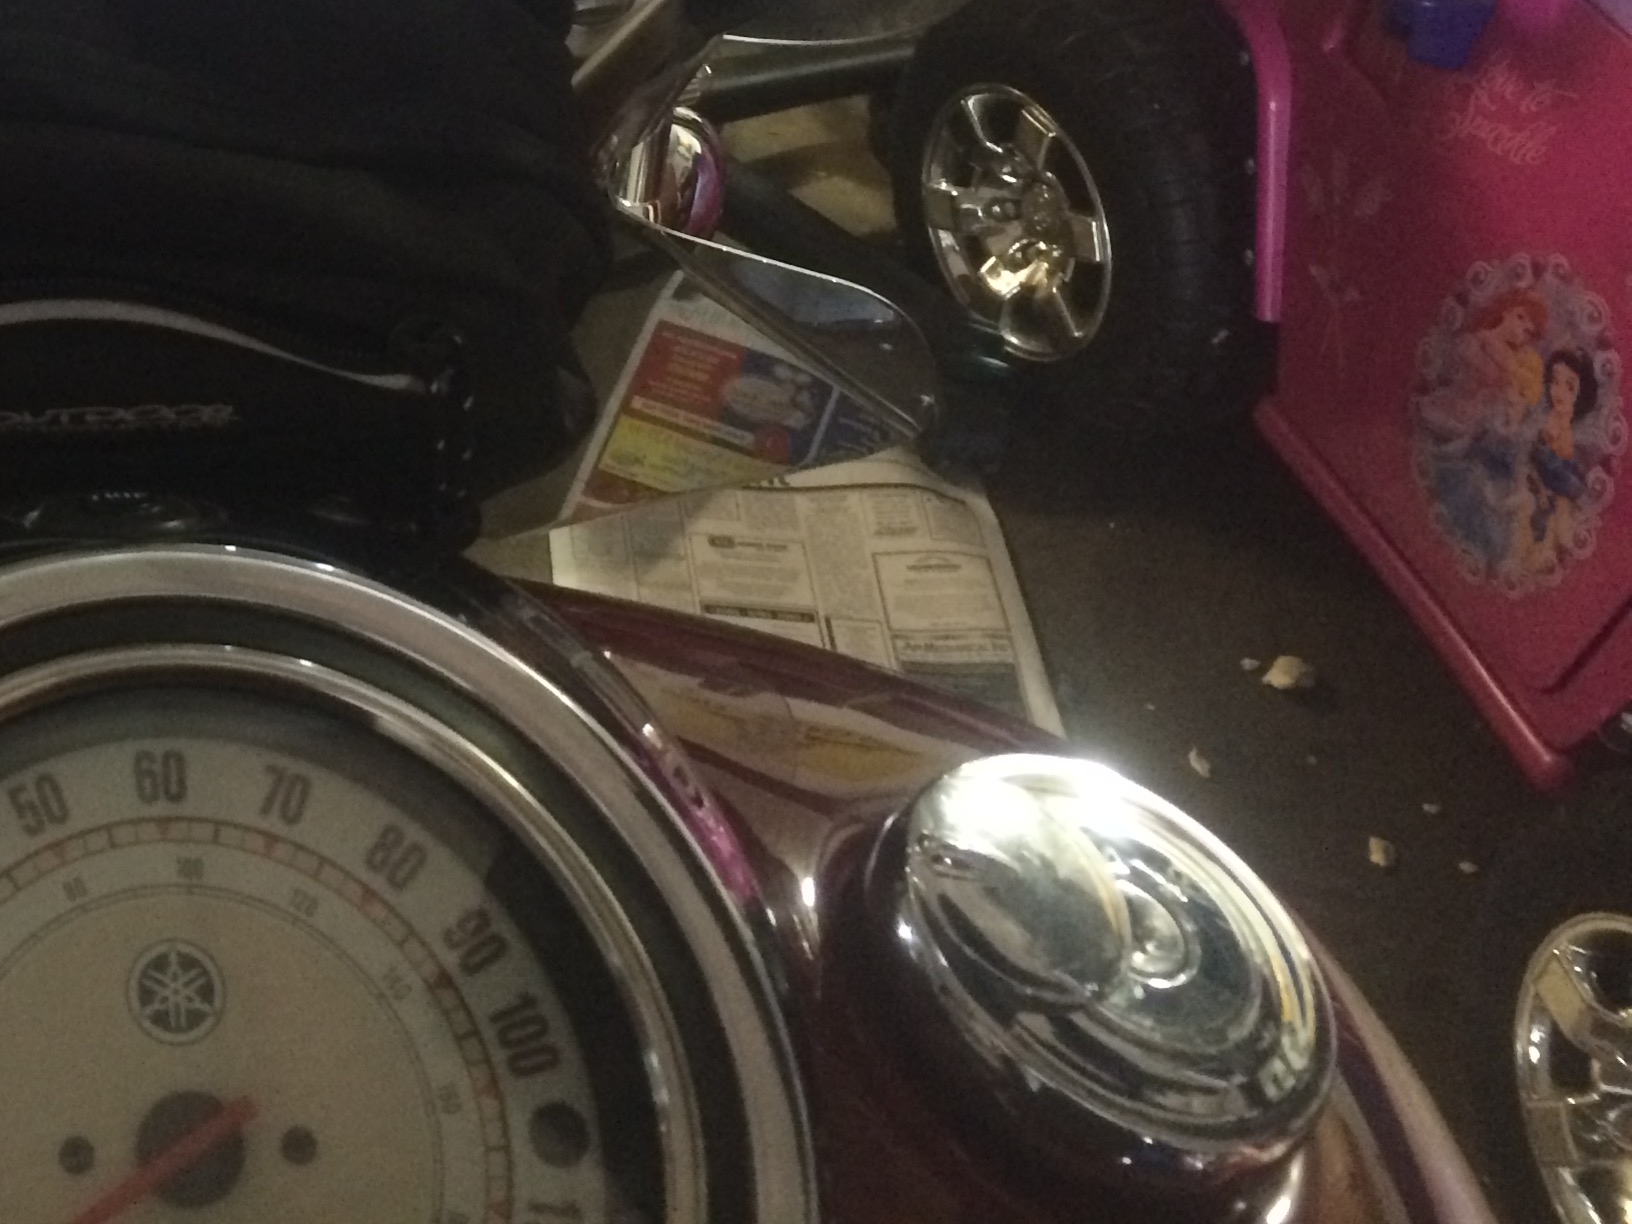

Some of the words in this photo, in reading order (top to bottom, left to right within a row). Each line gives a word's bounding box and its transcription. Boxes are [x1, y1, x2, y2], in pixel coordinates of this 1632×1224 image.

[9, 773, 71, 838] 50
[132, 747, 189, 805] 60
[258, 763, 313, 827] 70
[363, 820, 429, 892] 80
[442, 907, 508, 977] 90
[489, 991, 562, 1079] 100
